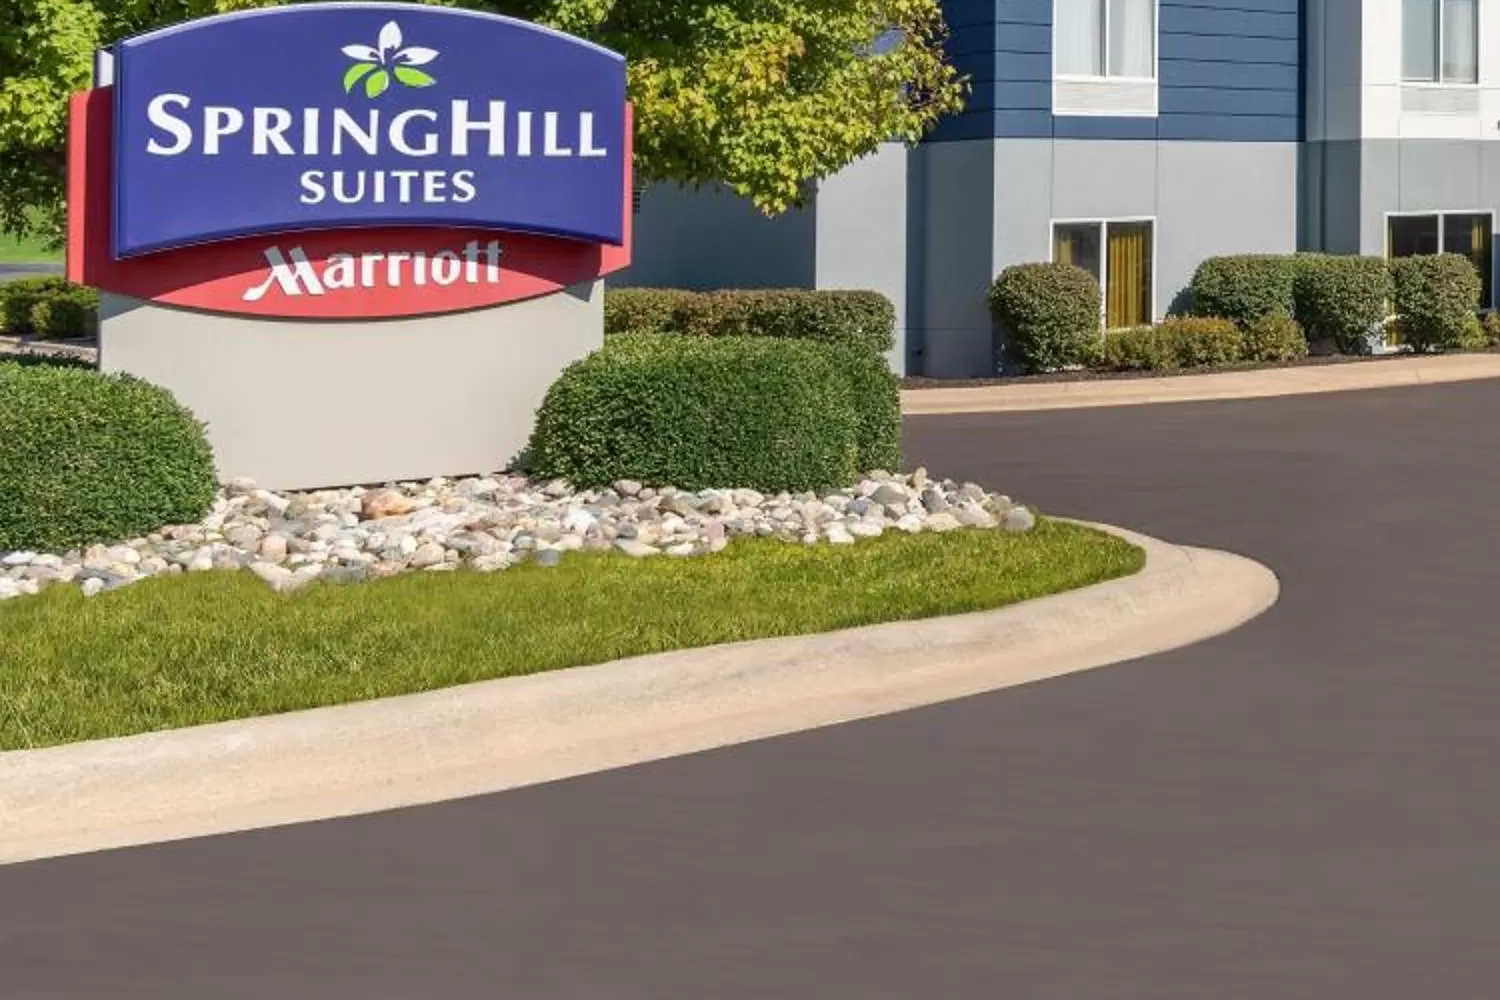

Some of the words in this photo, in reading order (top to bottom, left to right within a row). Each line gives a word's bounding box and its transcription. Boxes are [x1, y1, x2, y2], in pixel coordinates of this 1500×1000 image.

[145, 93, 608, 157] SPRINGHILL
[299, 169, 477, 204] SUITES
[241, 240, 503, 301] Marriott
